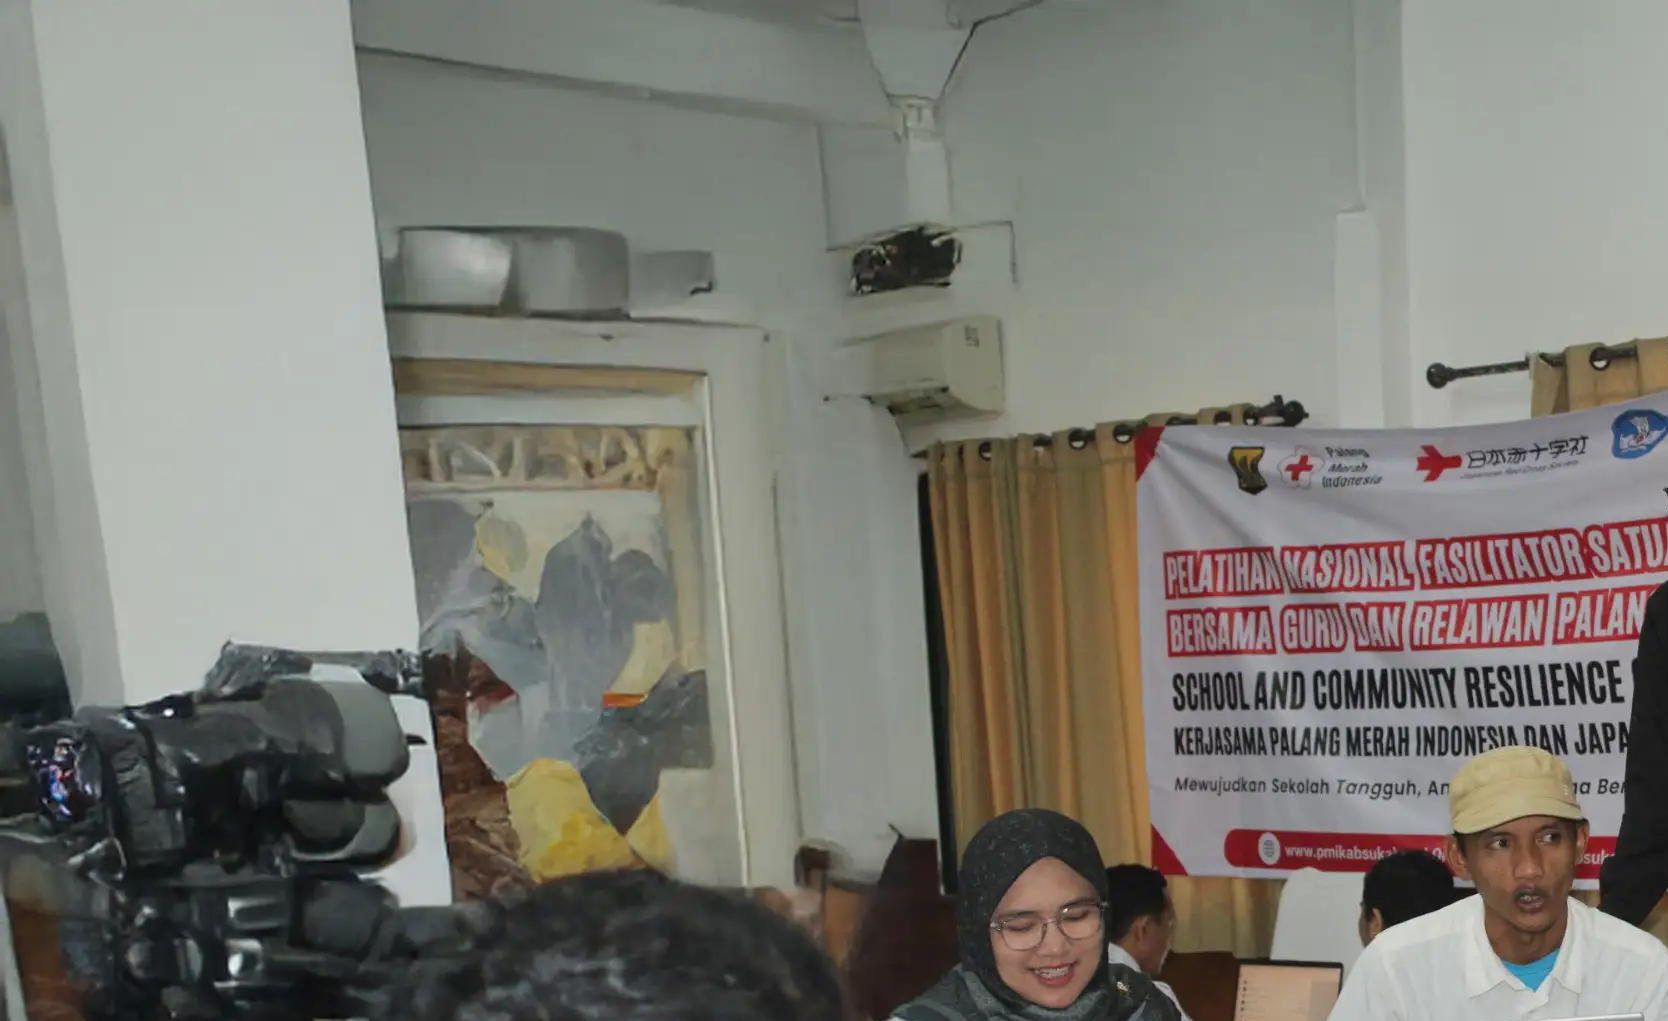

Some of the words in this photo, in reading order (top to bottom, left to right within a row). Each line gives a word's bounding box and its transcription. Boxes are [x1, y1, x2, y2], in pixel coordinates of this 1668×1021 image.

[1322, 474, 1382, 488] Indonesia
[1328, 462, 1368, 473] Merah
[1166, 551, 1281, 594] PELATIHAN
[1282, 545, 1411, 589] NASIONAL
[1419, 533, 1586, 586] FASILITATOR
[1169, 610, 1274, 654] BERSAMA
[1283, 606, 1347, 650] GURU
[1348, 604, 1402, 648] DAN
[1413, 598, 1546, 646] RELAWAN
[1556, 590, 1649, 640] PALAN
[1172, 671, 1250, 712] SCHOOL
[1254, 669, 1306, 711] AND
[1313, 667, 1457, 710] COMMUNITY
[1464, 660, 1626, 709] RESILIENCE
[1174, 726, 1268, 756] KERJASAMA
[1269, 726, 1341, 757] PALANG
[1346, 726, 1410, 757] MERAH
[1416, 724, 1519, 758] INDONESIA
[1523, 723, 1569, 756] DAN
[1574, 721, 1630, 755] JAPA
[1174, 776, 1267, 797] Mewujudkan
[1271, 778, 1330, 795] Sekolah
[1336, 778, 1421, 800] Tangguh,
[1428, 780, 1450, 796] An
